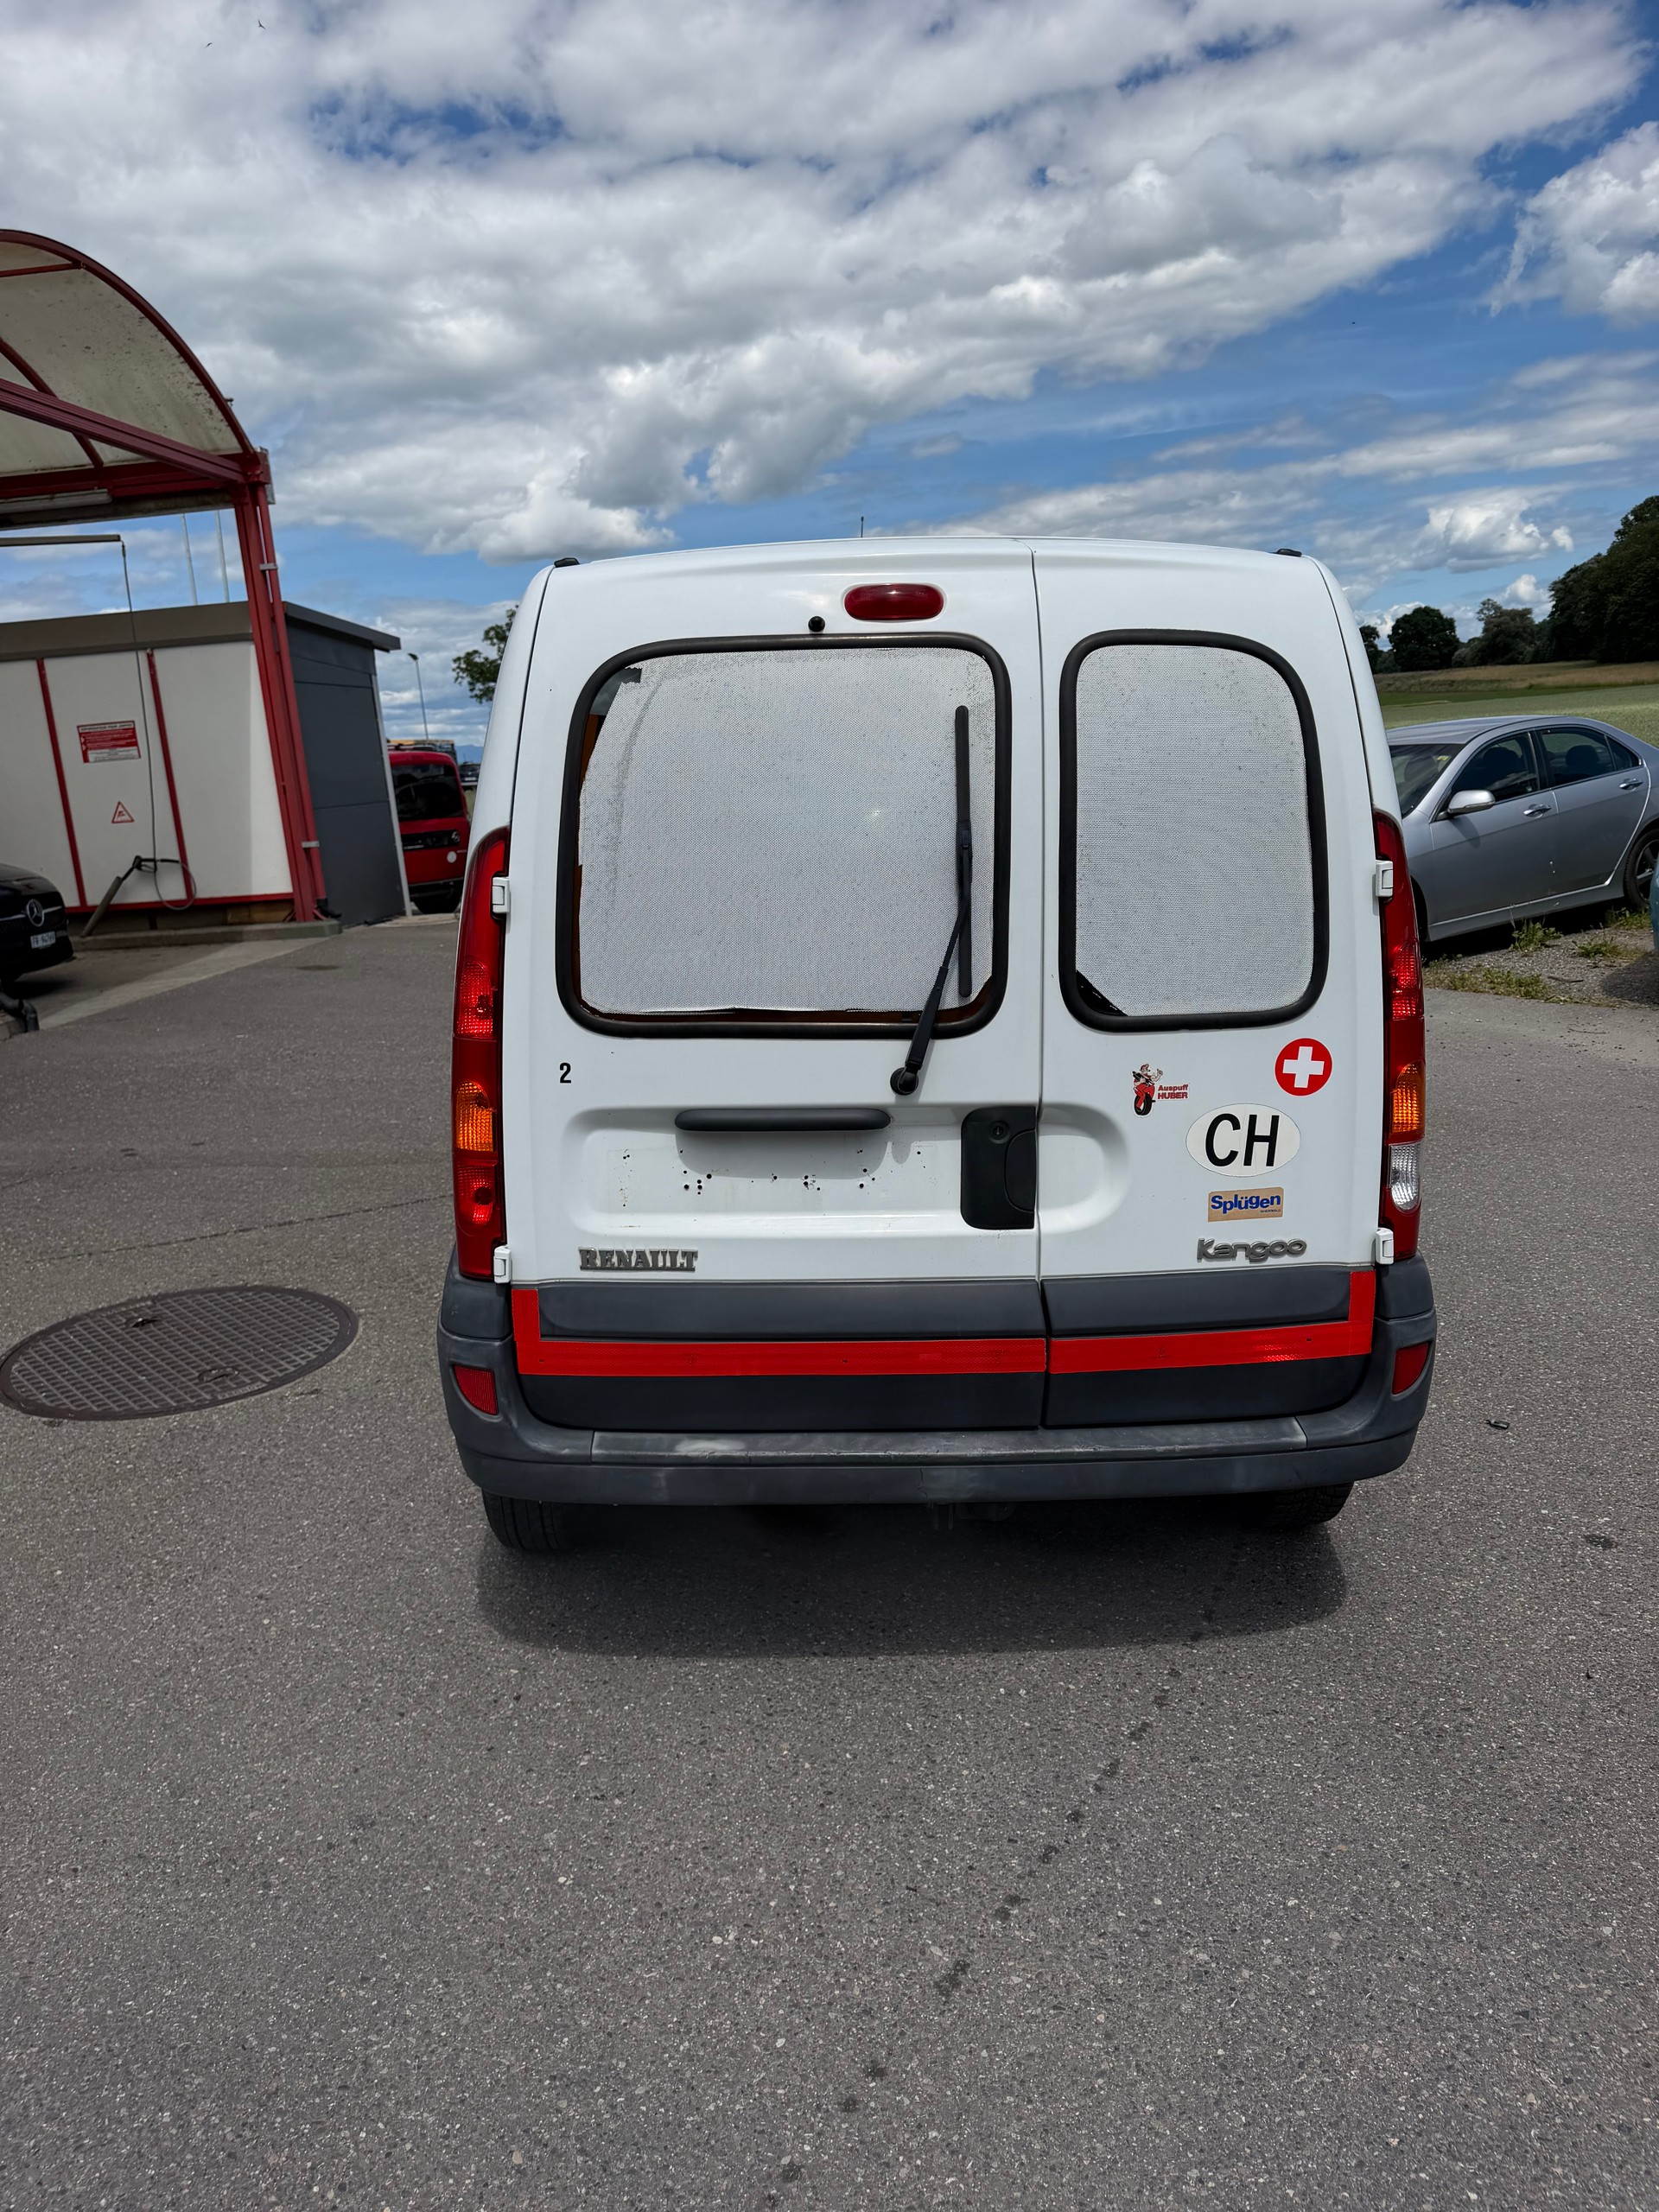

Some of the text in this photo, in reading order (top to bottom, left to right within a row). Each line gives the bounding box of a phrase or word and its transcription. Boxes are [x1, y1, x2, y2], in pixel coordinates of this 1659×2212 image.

[559, 1062, 572, 1084] 2
[1158, 1091, 1188, 1100] HUBER
[1205, 1113, 1280, 1167] CH
[1211, 1194, 1281, 1214] Splügen
[578, 1247, 698, 1272] RENAULT
[1197, 1238, 1307, 1263] Kangoo
